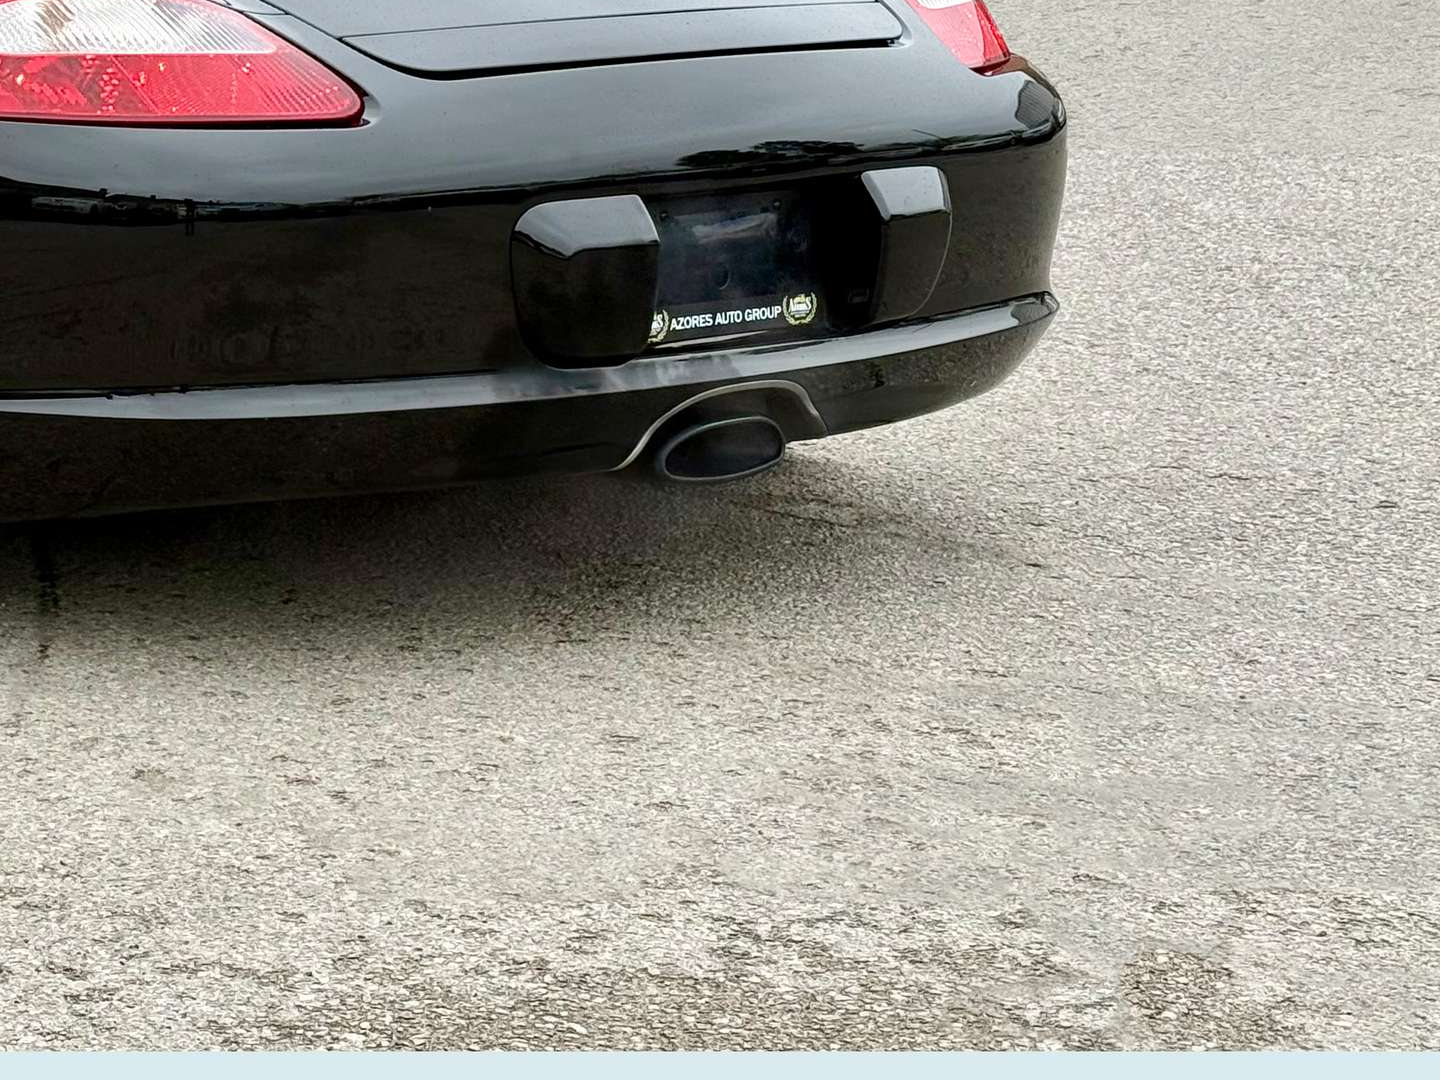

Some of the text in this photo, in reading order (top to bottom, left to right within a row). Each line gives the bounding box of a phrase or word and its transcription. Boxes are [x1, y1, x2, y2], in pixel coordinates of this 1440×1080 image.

[670, 313, 714, 332] AZORES
[715, 310, 743, 326] AUTO
[744, 305, 782, 322] GROUP
